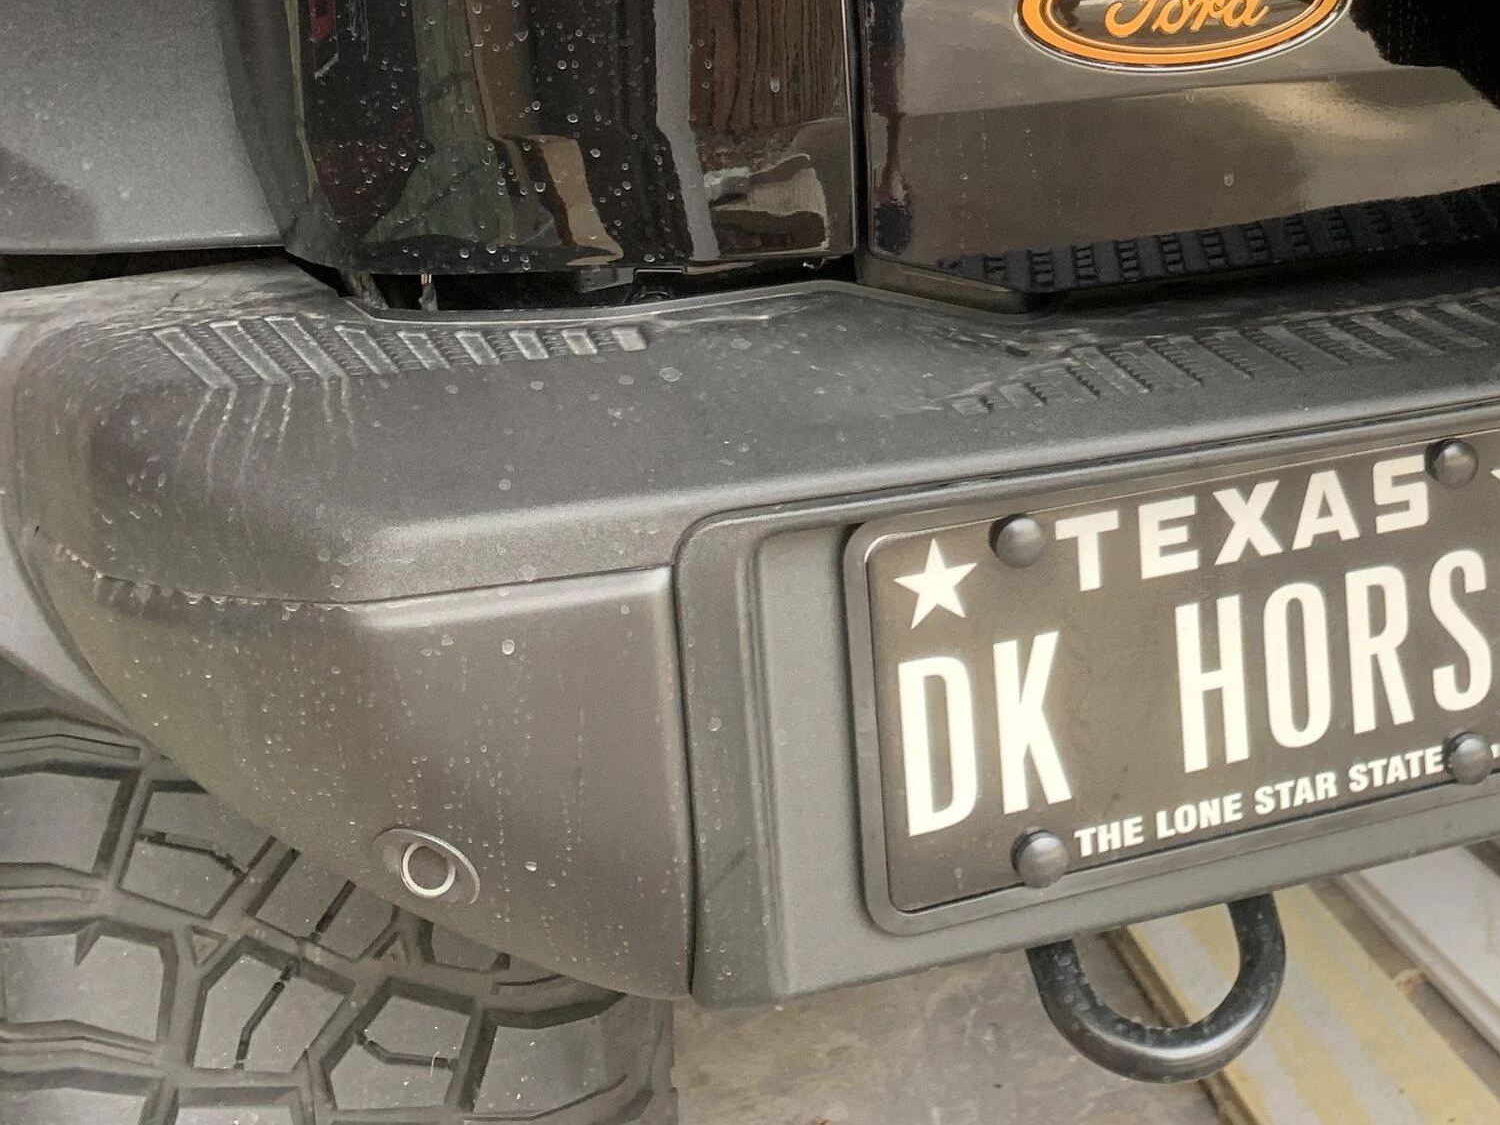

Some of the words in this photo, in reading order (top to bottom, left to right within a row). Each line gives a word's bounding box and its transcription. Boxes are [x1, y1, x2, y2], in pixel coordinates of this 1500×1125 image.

[1055, 455, 1430, 592] TEXAS
[897, 630, 1072, 837] DK
[1074, 815, 1145, 858] THE
[1156, 791, 1244, 840] LONE
[1254, 770, 1339, 815] STAR
[1348, 745, 1445, 792] STATE
